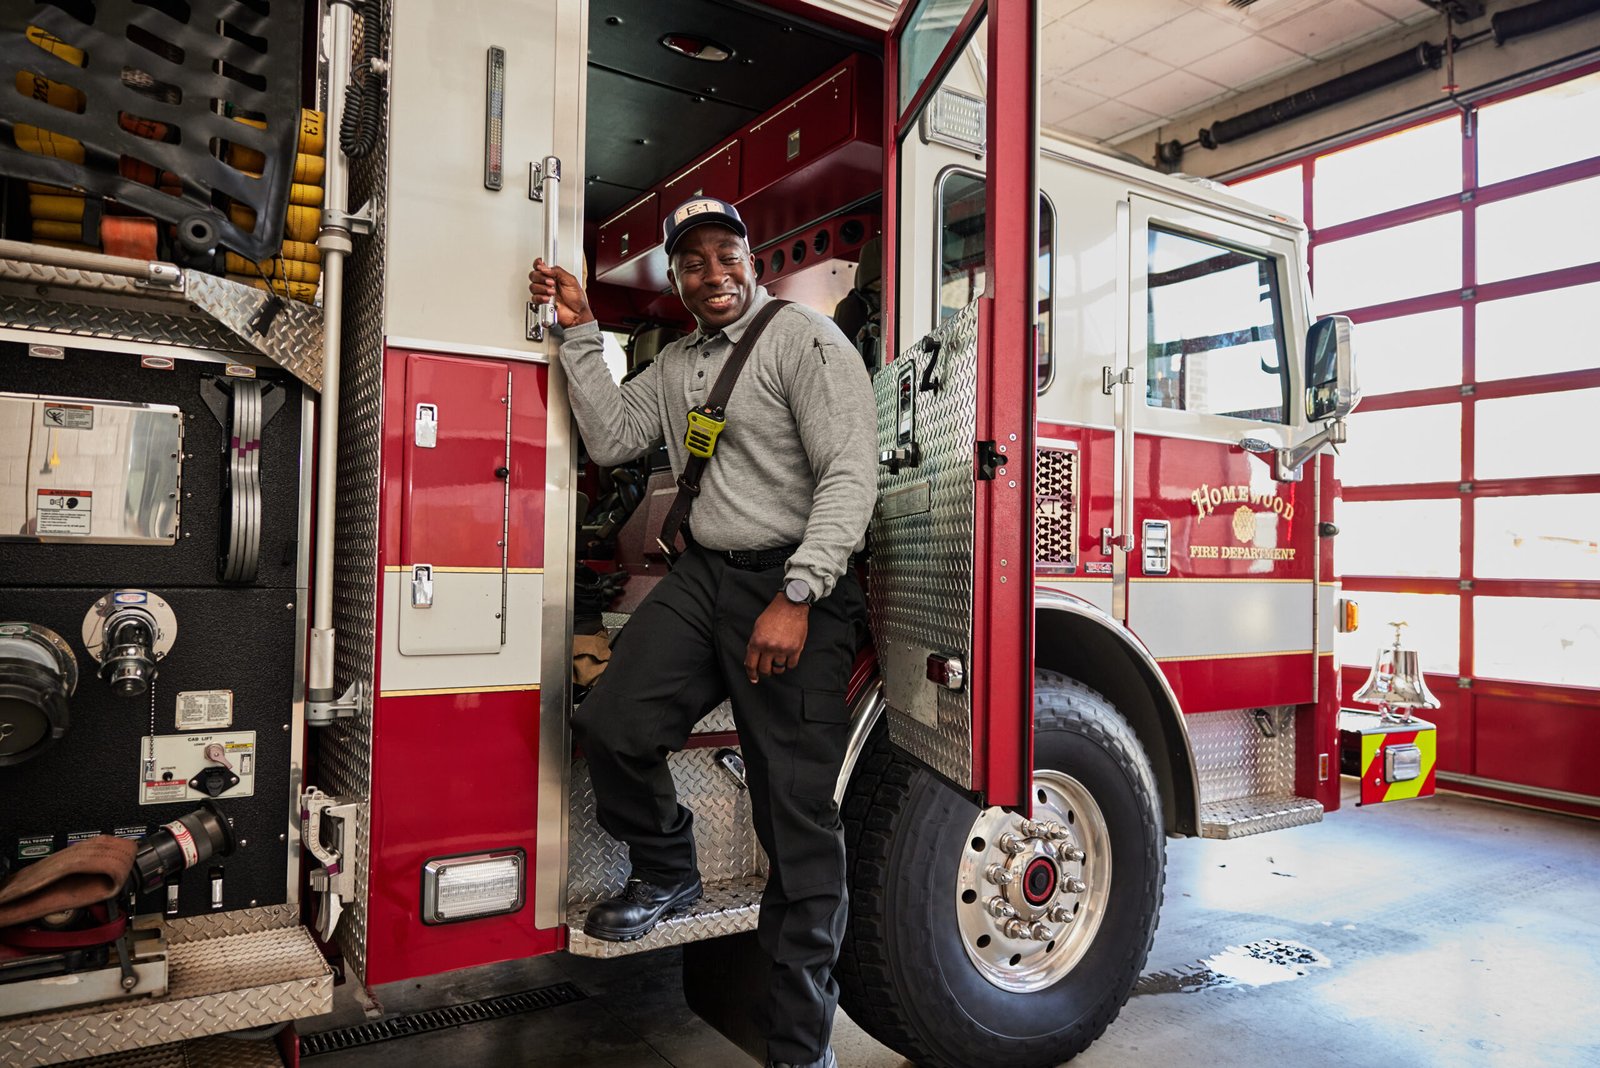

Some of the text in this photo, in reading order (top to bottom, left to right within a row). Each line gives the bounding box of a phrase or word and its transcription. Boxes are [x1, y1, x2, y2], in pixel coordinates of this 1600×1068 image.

[686, 203, 709, 215] E-1
[1190, 483, 1295, 525] HOMEWOOD
[1190, 546, 1296, 560] FIRE DEPARTMENT
